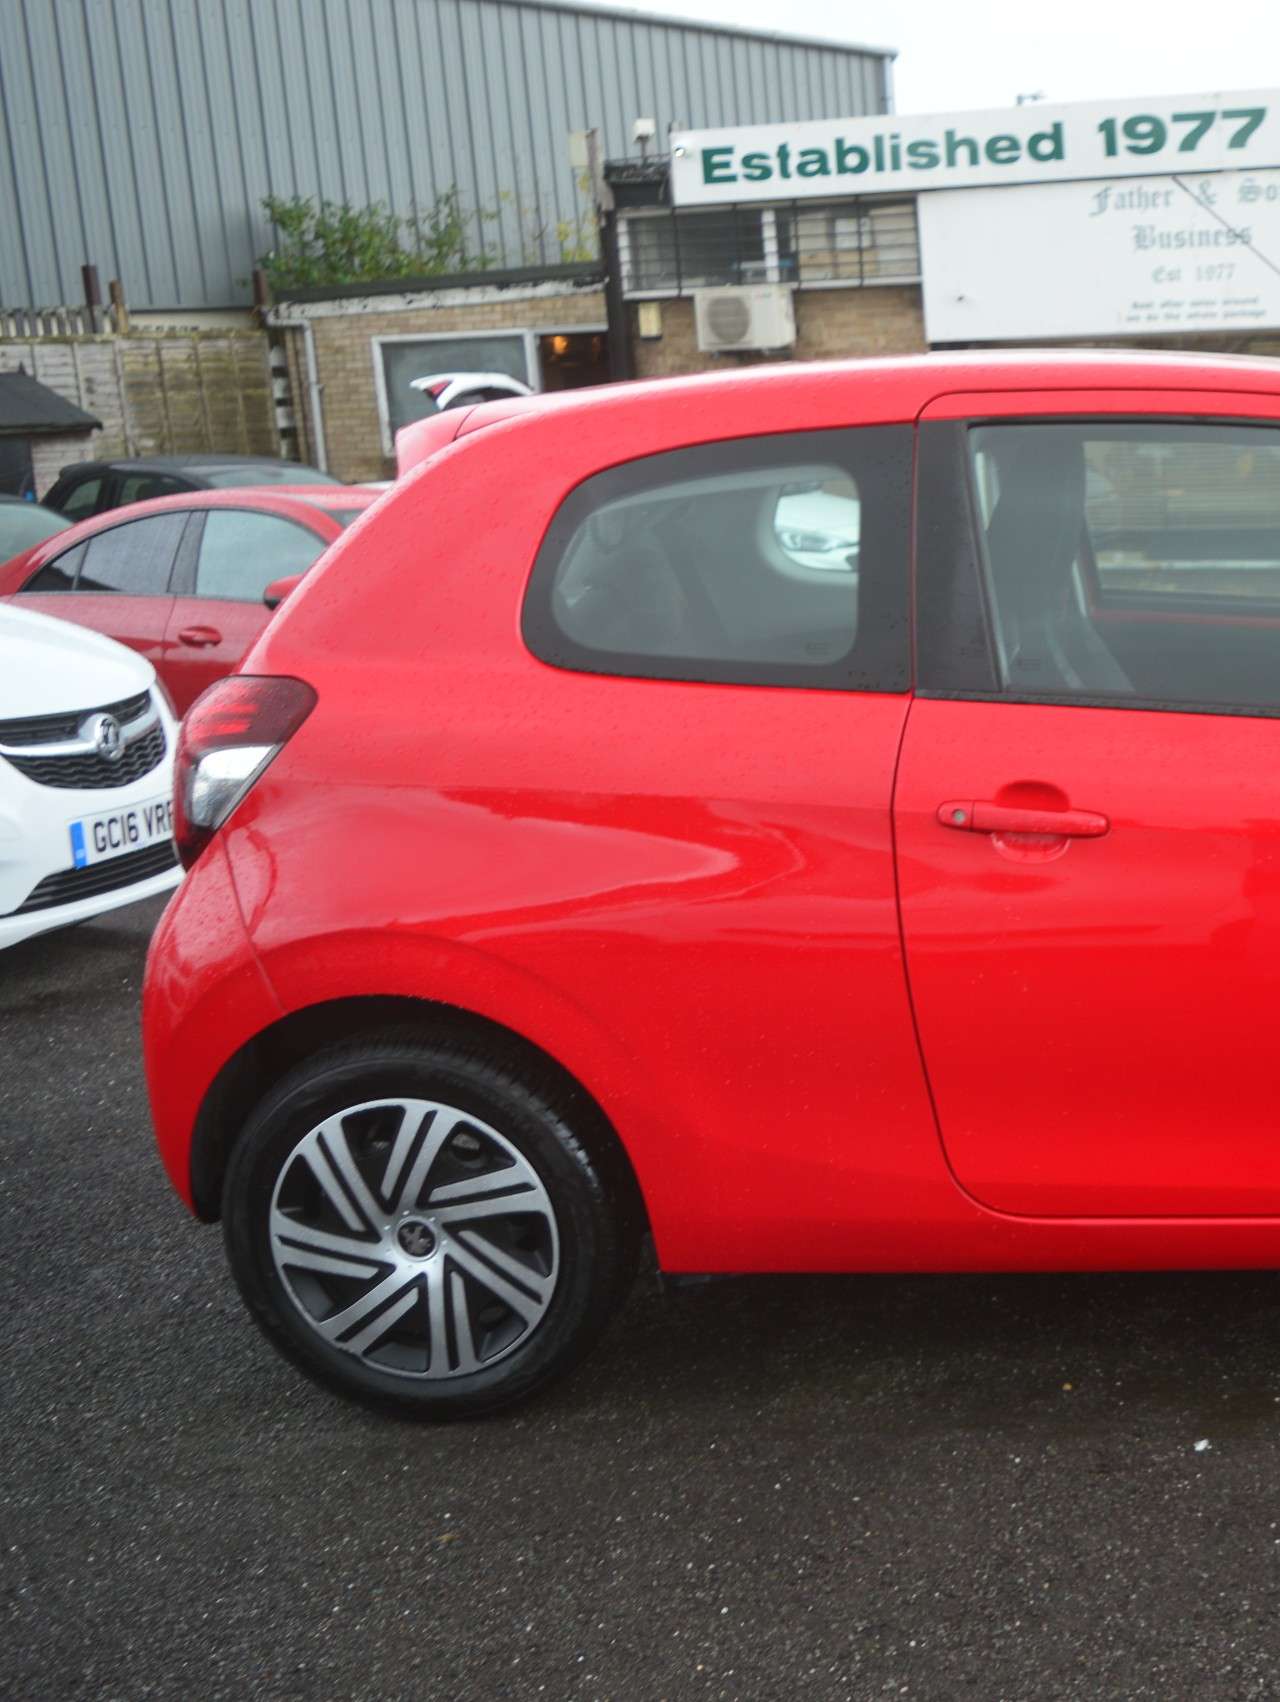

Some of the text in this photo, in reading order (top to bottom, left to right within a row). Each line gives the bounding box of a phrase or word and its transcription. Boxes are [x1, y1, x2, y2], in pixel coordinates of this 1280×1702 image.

[701, 106, 1268, 185] Established 1977
[1089, 184, 1173, 217] Father
[1199, 179, 1217, 207] &
[1132, 225, 1251, 251] Business
[1152, 263, 1236, 284] Est 1977
[94, 811, 140, 852] GC16
